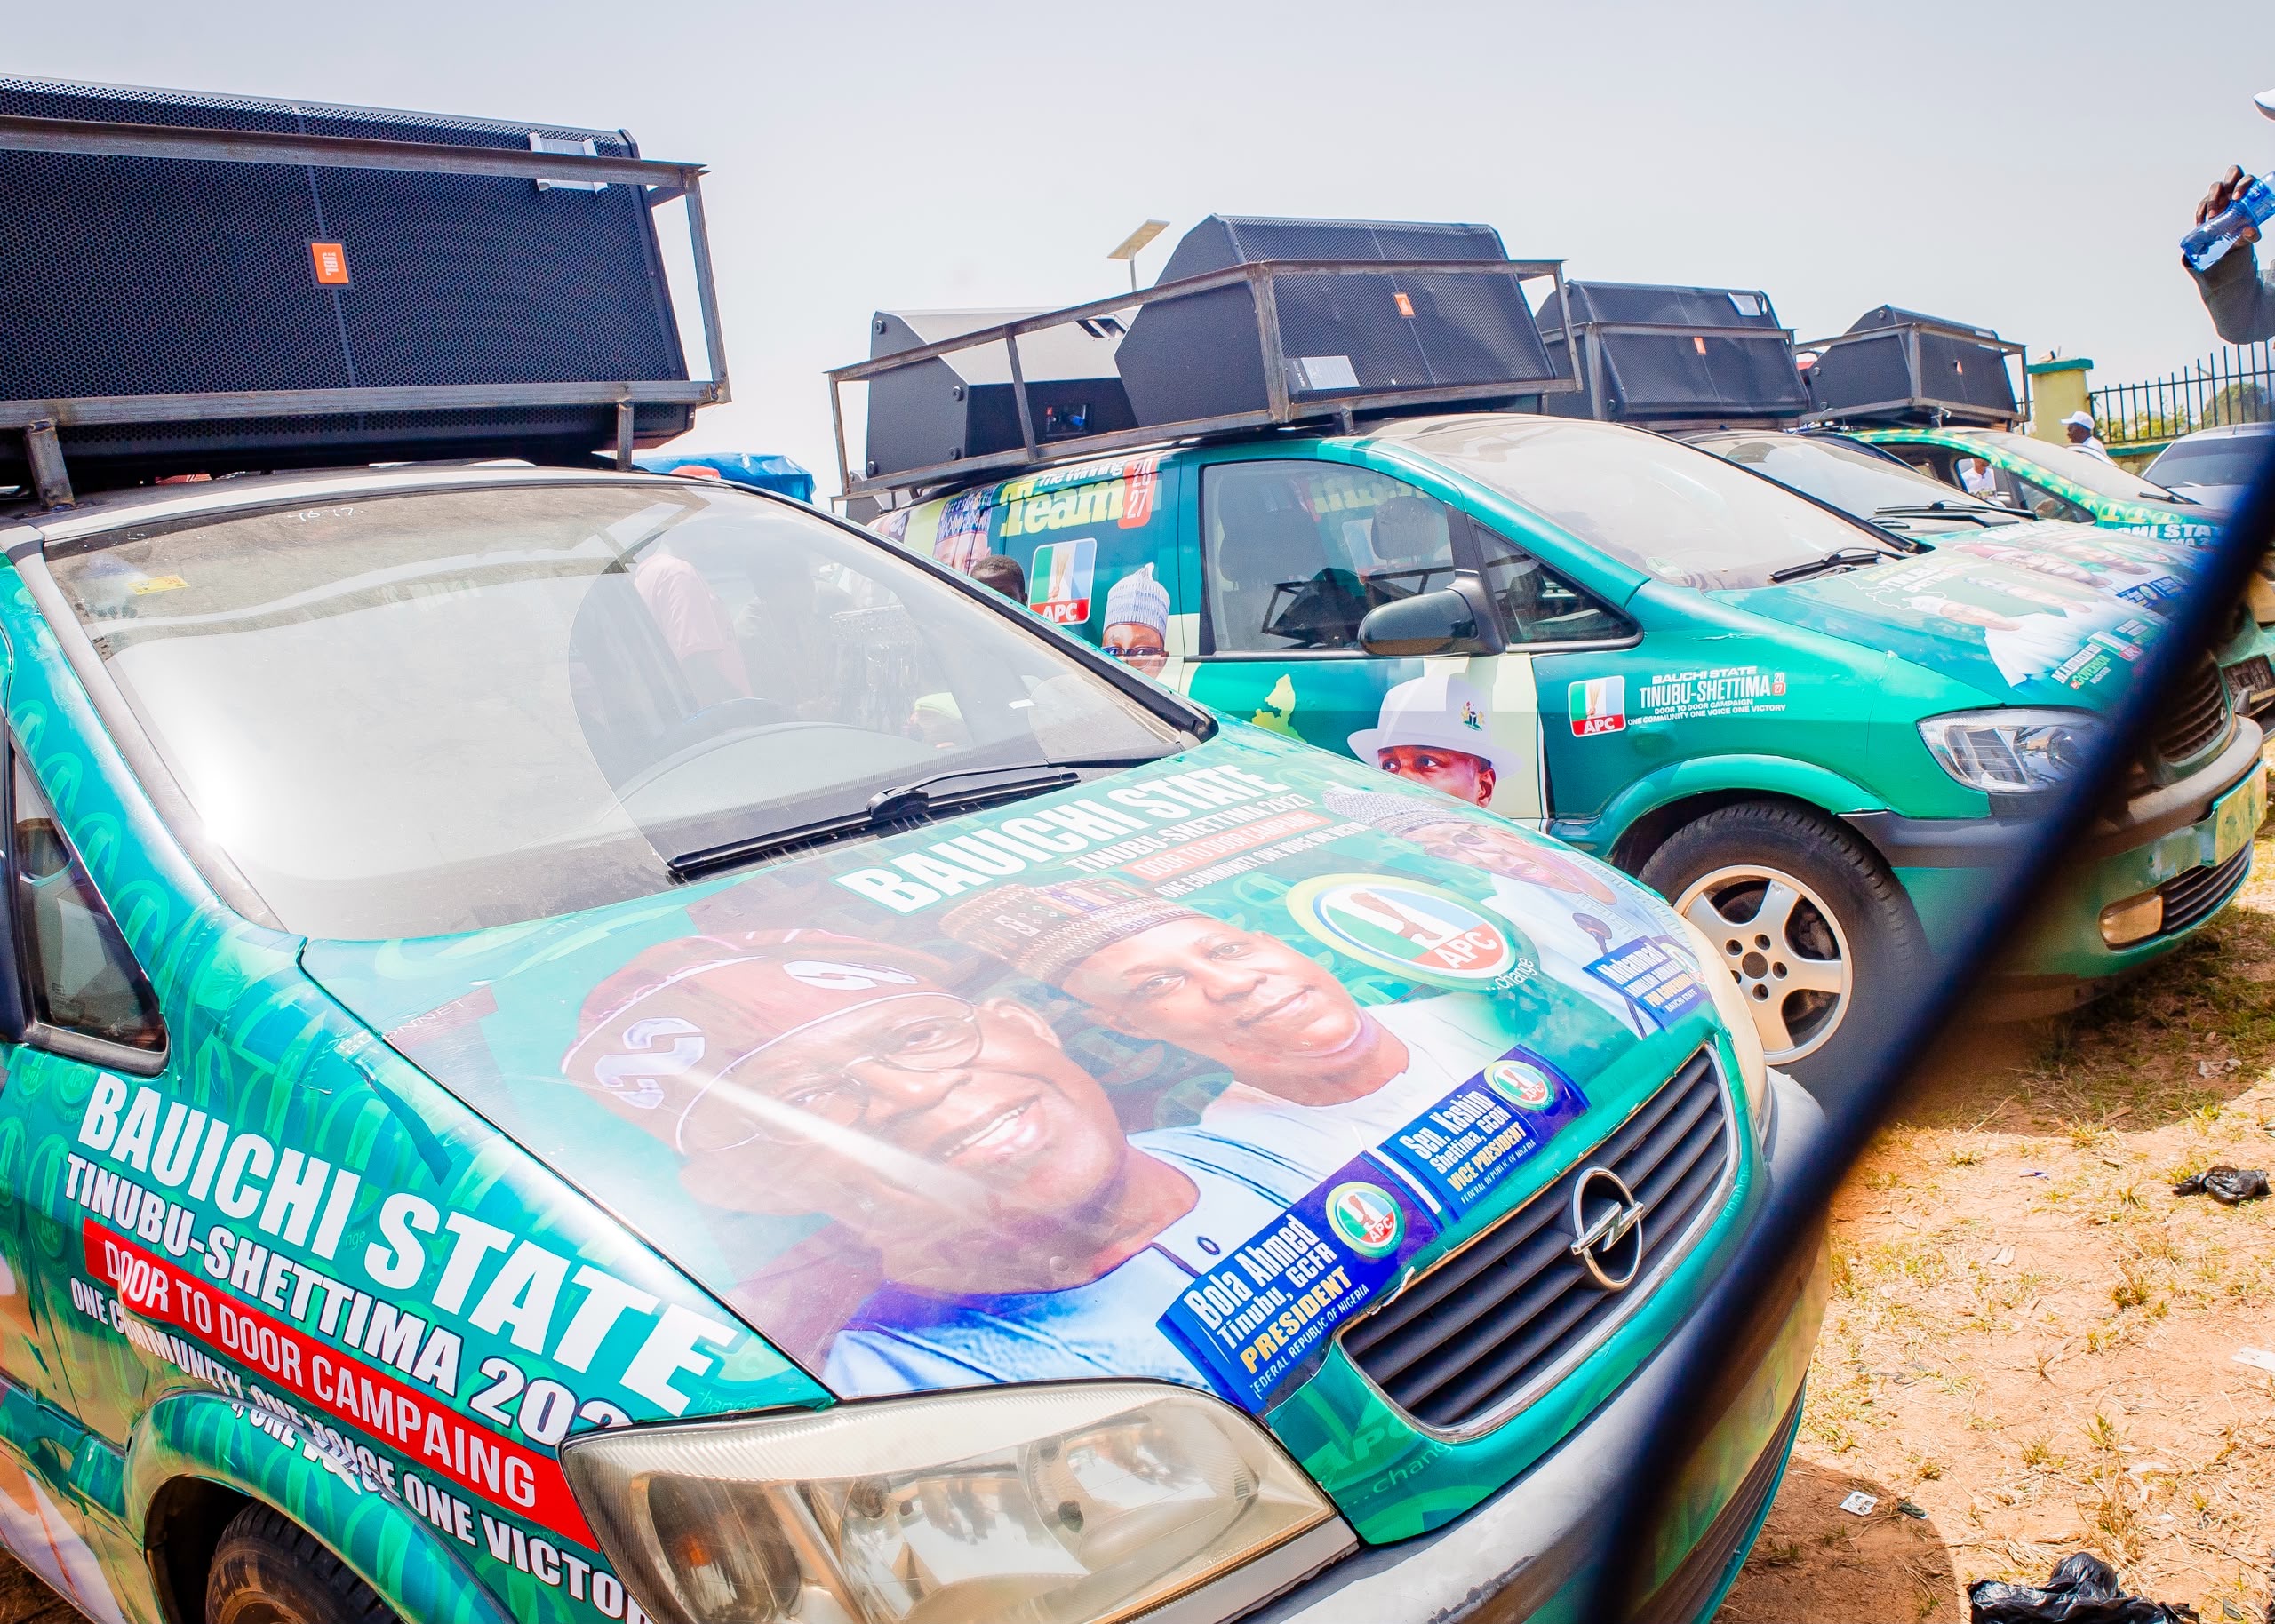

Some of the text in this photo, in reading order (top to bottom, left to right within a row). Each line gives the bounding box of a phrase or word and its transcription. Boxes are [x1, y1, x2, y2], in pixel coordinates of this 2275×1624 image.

[322, 251, 339, 276] JBL
[1038, 471, 1065, 488] The
[1131, 458, 1153, 488] 20
[999, 478, 1126, 537] Team
[1126, 489, 1149, 519] 27
[1042, 601, 1079, 622] APC
[1651, 665, 1758, 685] BAUCHI STATE
[1774, 672, 1785, 683] 20
[1774, 683, 1784, 694] 27
[1639, 675, 1771, 709] TINUBU-SHETTIMA
[1654, 706, 1675, 715] DOOR
[1688, 702, 1709, 711] DOOR
[1710, 697, 1753, 709] CAMPAIGN
[1583, 718, 1616, 735] APC
[1627, 703, 1786, 726] ONE COMMUNITY ONE VOICE ONE VICTORY
[834, 764, 1292, 913] BAUICHI STATE
[1060, 803, 1272, 873] TINUBU-SHETTIMA
[1132, 853, 1187, 876] DOOR
[1178, 843, 1214, 861] TO
[1154, 881, 1196, 898] ONE
[1433, 930, 1498, 969] APC
[1643, 991, 1666, 1008] FOR
[1664, 988, 1698, 1013] BAUCHI STATE
[384, 998, 465, 1041] ONNET
[1525, 1084, 1545, 1101] APC
[1399, 1090, 1496, 1159] Sen. Kashim
[1429, 1105, 1512, 1174] Shettima, GCON
[1446, 1121, 1527, 1192] VICE PRESIDENT
[77, 1071, 739, 1417] BAUICHI STATE
[1369, 1216, 1393, 1242] APC
[66, 1152, 464, 1398] TINUBU-SHETTIMA
[1183, 1214, 1321, 1331] Bola Ahmed
[1216, 1242, 1338, 1349] Tinubu, GCFR
[1239, 1265, 1353, 1374] PRESIDENT
[1249, 1283, 1370, 1400] FEDERAL REPUBLIC OF NIGERIA
[104, 1239, 536, 1508] DOOR TO DOOR CAMPAING
[70, 1277, 109, 1325] ONE
[403, 1472, 478, 1548] ONE
